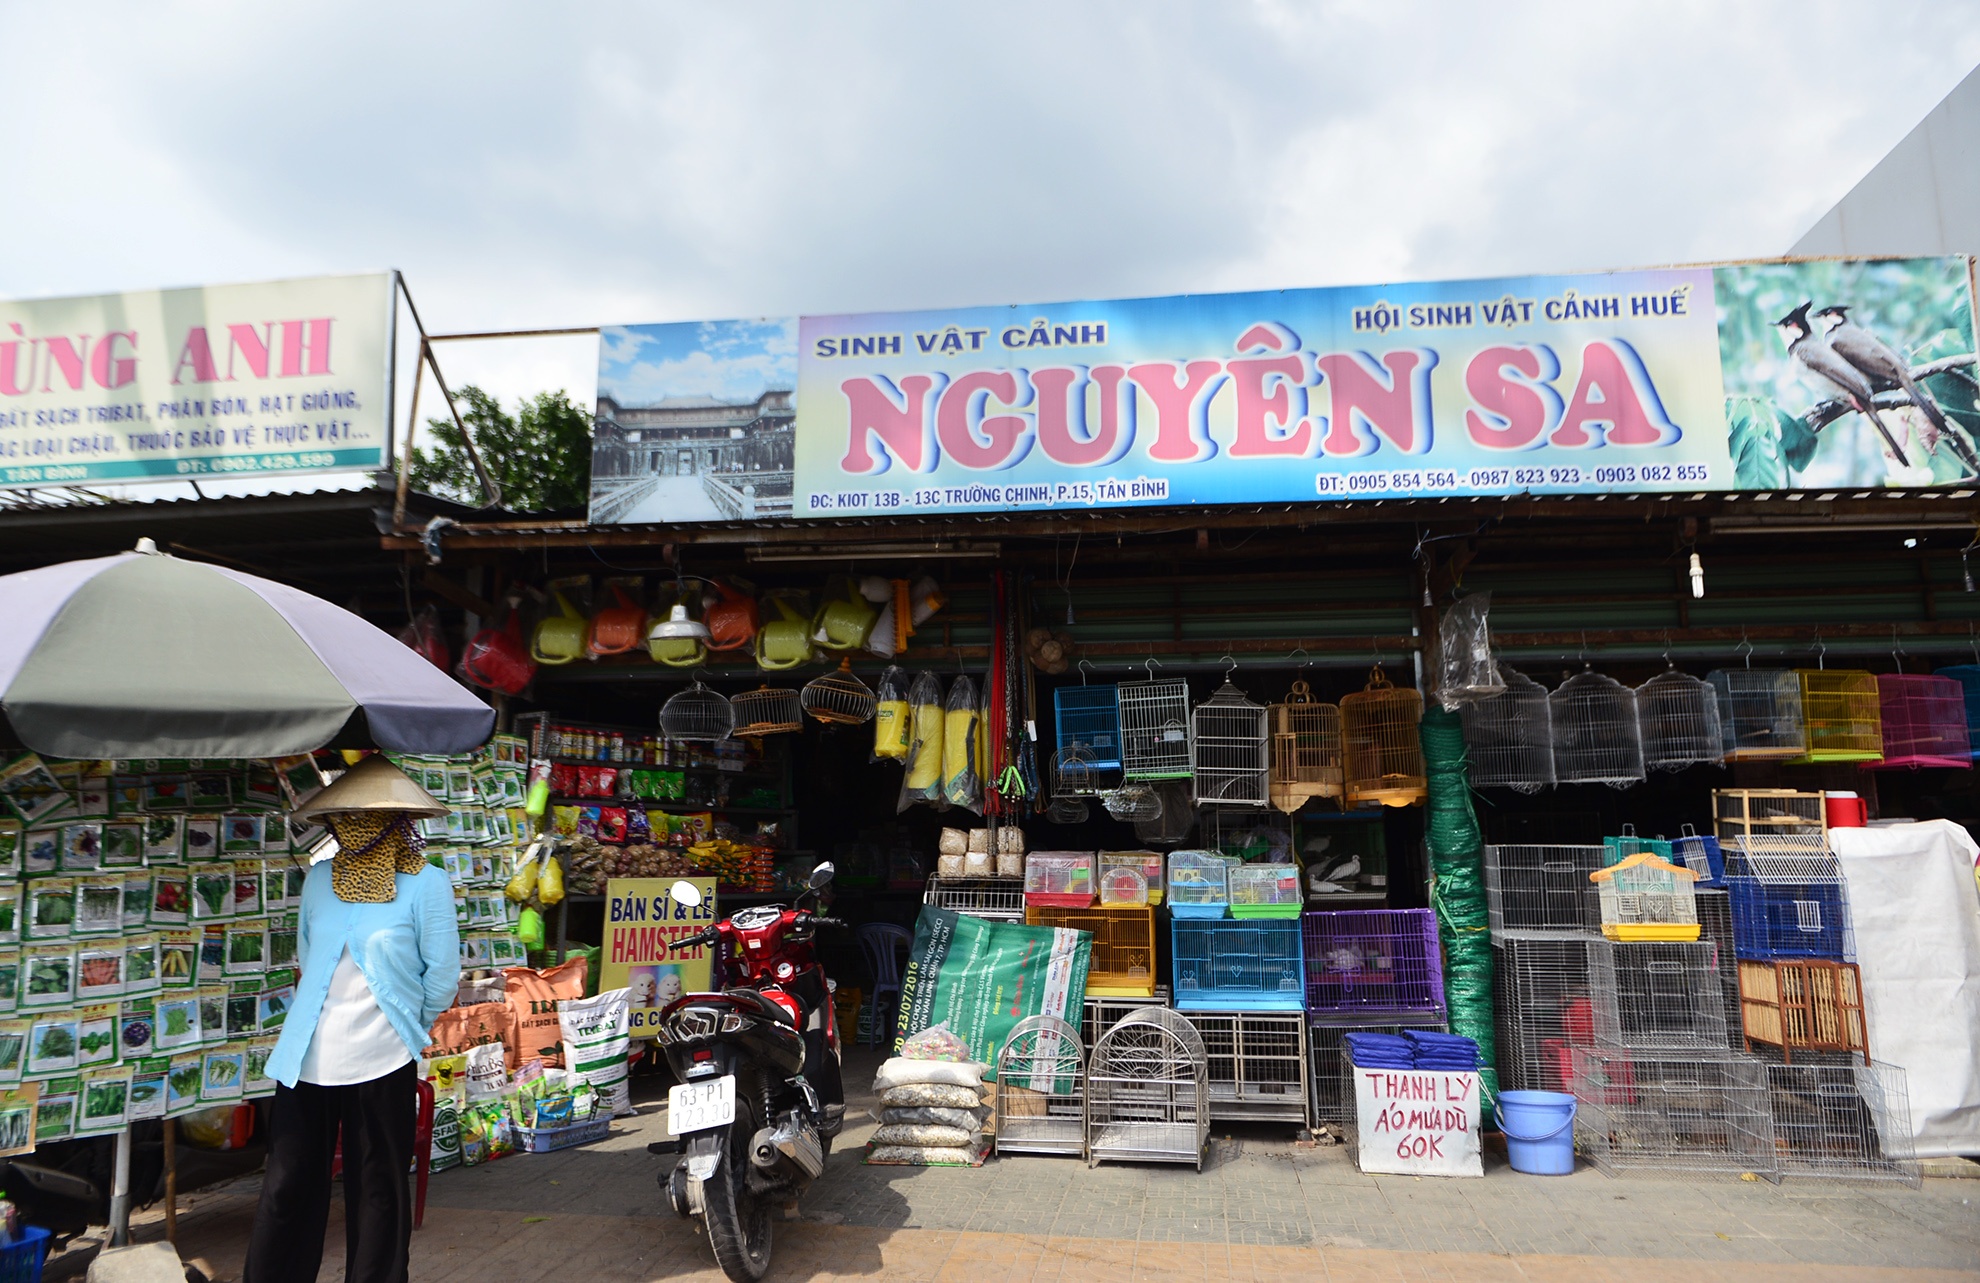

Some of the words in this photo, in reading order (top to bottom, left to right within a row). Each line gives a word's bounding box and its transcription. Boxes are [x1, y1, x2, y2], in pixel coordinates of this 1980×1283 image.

[1355, 302, 1400, 332] HỘI
[1410, 304, 1472, 327] SINH
[1483, 297, 1534, 328] VẬT
[1545, 292, 1620, 321] CẢNH
[1631, 286, 1690, 316] HUẾ
[169, 317, 338, 385] ANH
[815, 335, 901, 357] SINH
[916, 328, 987, 356] VẬT
[1002, 320, 1105, 349] CẢNH
[260, 393, 295, 418] HẠT
[840, 323, 1430, 474] NGUYÊN
[1465, 340, 1675, 451] SA
[128, 429, 185, 451] THUỐC
[190, 423, 226, 449] BẢO
[233, 424, 256, 450] VỆ
[264, 423, 310, 448] THỰC
[1319, 477, 1344, 491] ĐT:
[1350, 475, 1386, 490] 0905
[1392, 472, 1420, 487] 854
[1427, 472, 1455, 487] 564
[1471, 470, 1509, 486] 0987
[1516, 469, 1545, 484] 823
[1550, 468, 1580, 483] 923
[1596, 467, 1636, 483] 0903
[1641, 466, 1672, 481] 082
[1677, 465, 1707, 480] 855
[810, 494, 833, 509] ĐC:
[838, 493, 869, 508] KIOT
[874, 492, 900, 507] 13B
[915, 490, 940, 505] 13C
[945, 485, 1000, 504] TRƯỜNG
[1005, 486, 1052, 503] CHINH,
[1058, 484, 1093, 503] P.15,
[1098, 481, 1126, 499] TÂN
[1132, 479, 1166, 497] BÌNH
[611, 890, 648, 922] BÁN
[652, 887, 671, 921] SỈ
[674, 899, 687, 921] &
[692, 887, 713, 920] LẺ
[612, 926, 705, 963] HAMSTER
[940, 926, 950, 942] HCM
[897, 960, 919, 1030] 23/07/2016
[680, 1082, 723, 1108] 63-P1
[1365, 1073, 1437, 1102] THANH
[1445, 1073, 1472, 1102] LÝ
[674, 1101, 731, 1130] 123.30
[1374, 1102, 1405, 1134] ÁO
[1396, 1133, 1445, 1161] 60K
